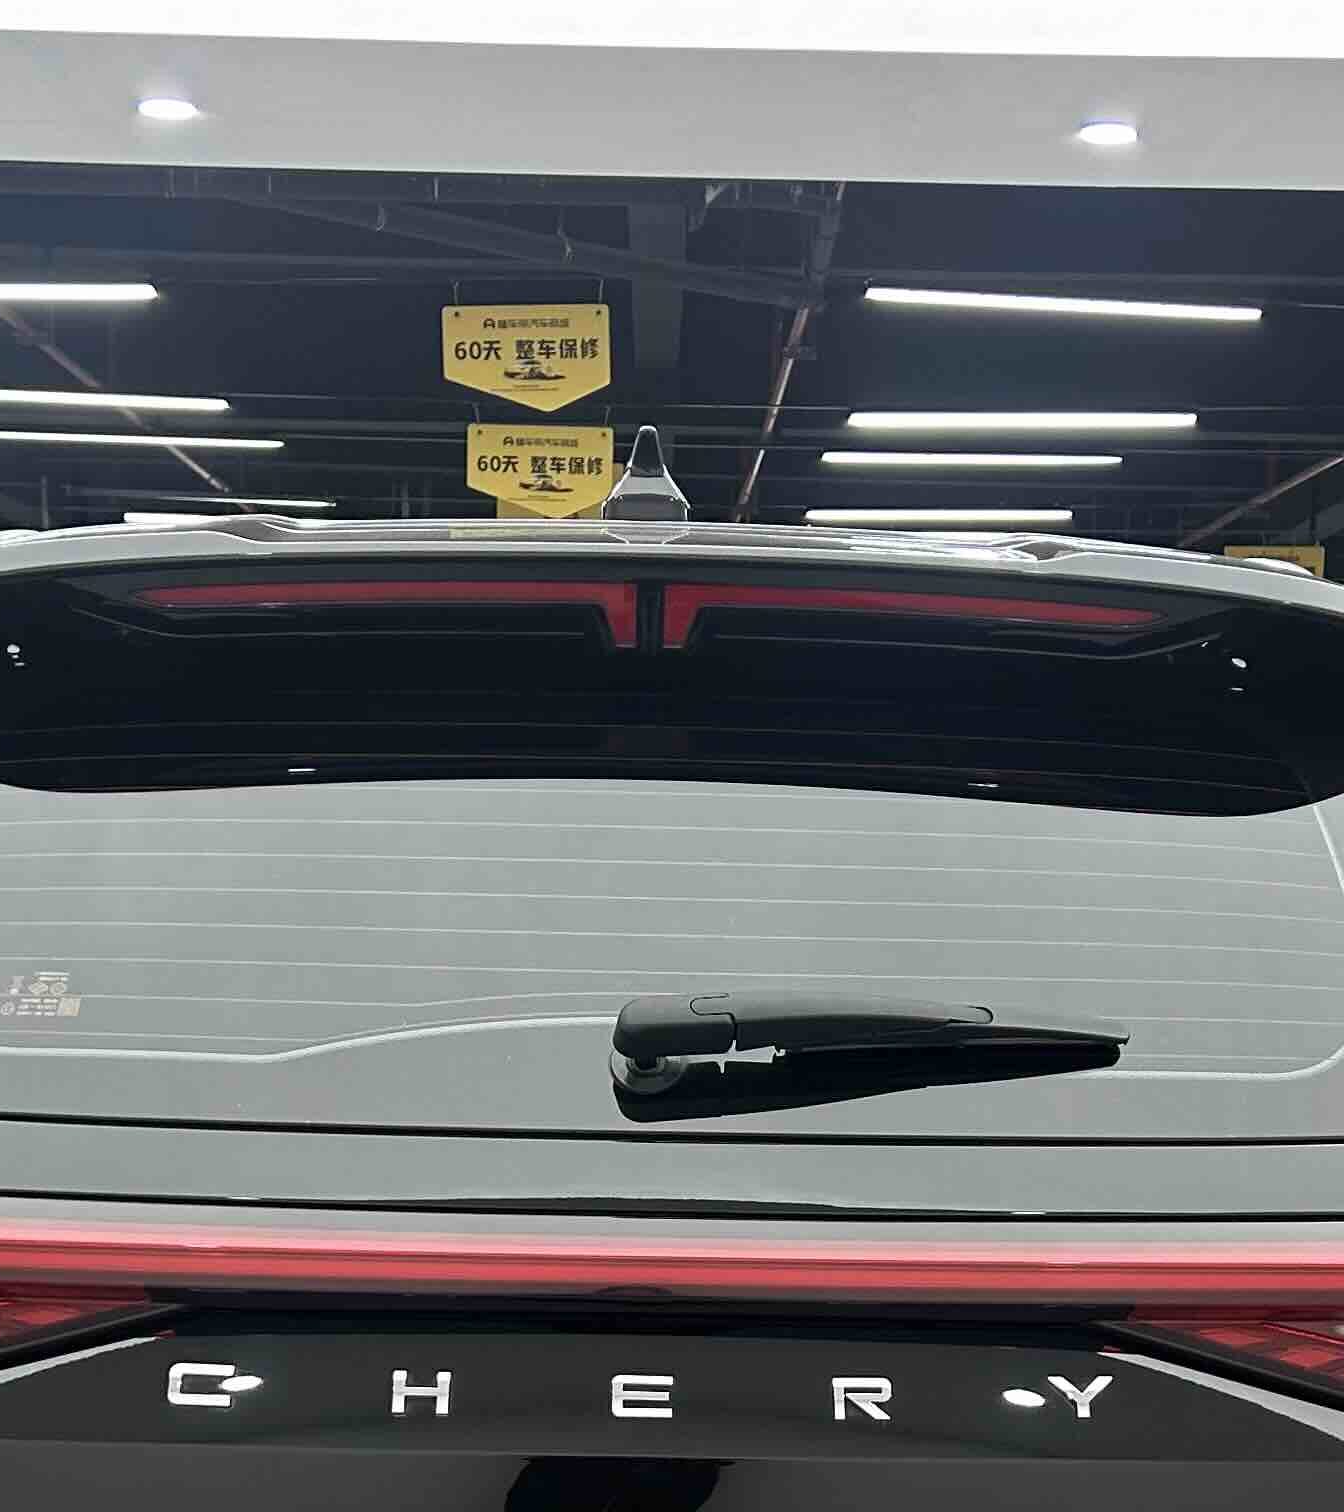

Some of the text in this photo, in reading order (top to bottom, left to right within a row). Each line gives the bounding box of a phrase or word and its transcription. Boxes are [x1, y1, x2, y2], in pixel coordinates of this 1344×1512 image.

[455, 336, 600, 361] 60天 整车保修
[477, 455, 604, 475] 60天 整车保修
[167, 1362, 1113, 1420] CHERY
